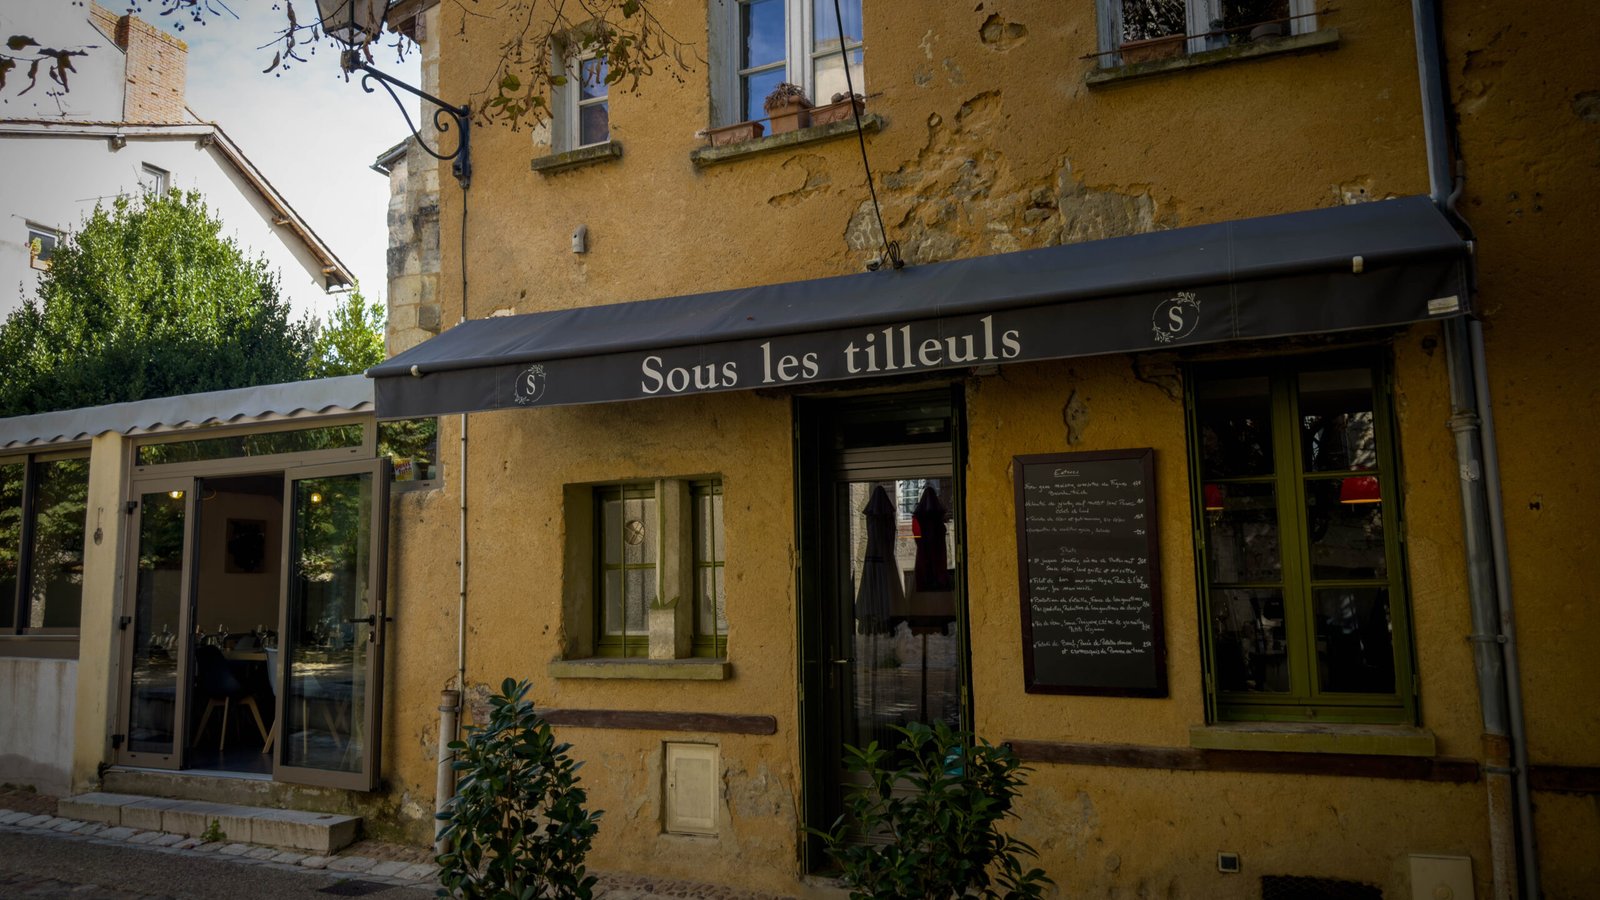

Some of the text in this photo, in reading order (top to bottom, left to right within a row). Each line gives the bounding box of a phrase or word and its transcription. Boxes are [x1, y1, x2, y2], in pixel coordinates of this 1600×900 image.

[1169, 306, 1183, 332] S
[641, 314, 1021, 394] Sous les tilleuls
[526, 374, 536, 395] S
